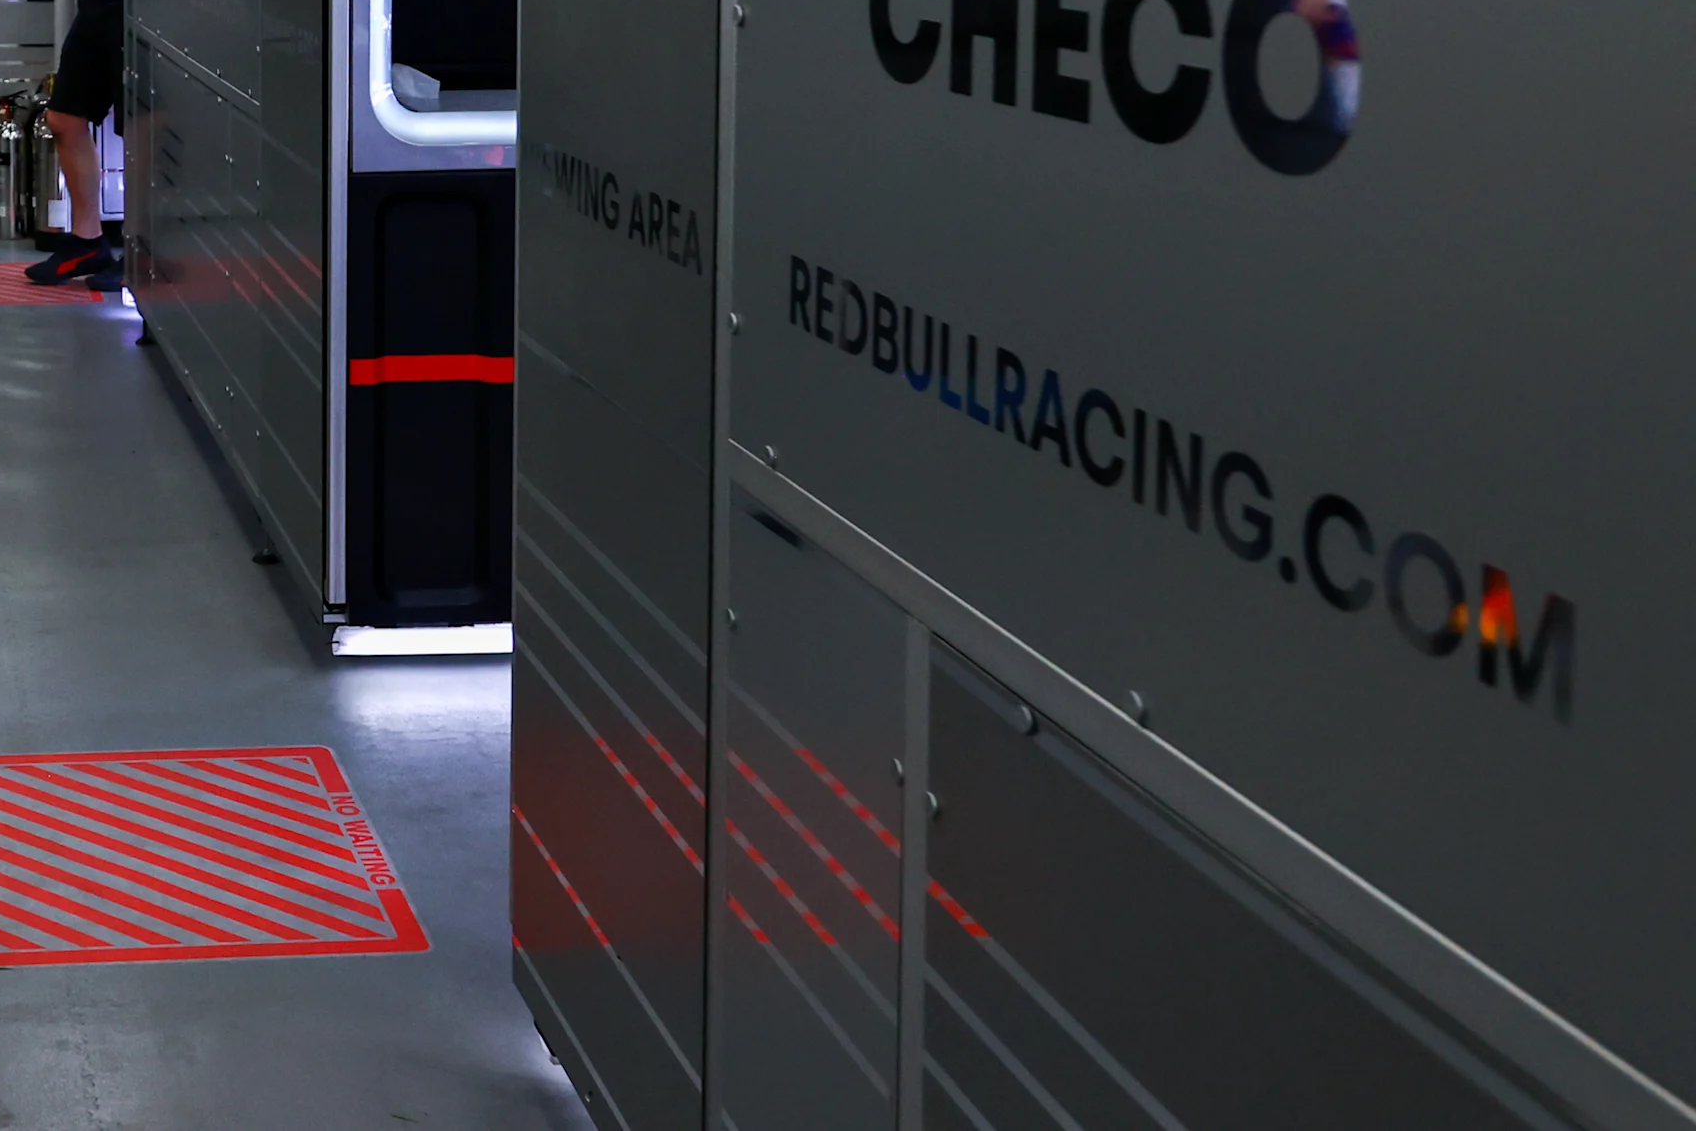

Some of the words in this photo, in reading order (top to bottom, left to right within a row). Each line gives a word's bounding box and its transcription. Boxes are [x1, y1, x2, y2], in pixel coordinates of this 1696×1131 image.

[627, 188, 703, 277] AREA
[788, 254, 1577, 727] REDBULLRACING.COM
[331, 796, 361, 816] NO
[344, 820, 397, 886] WAITING
